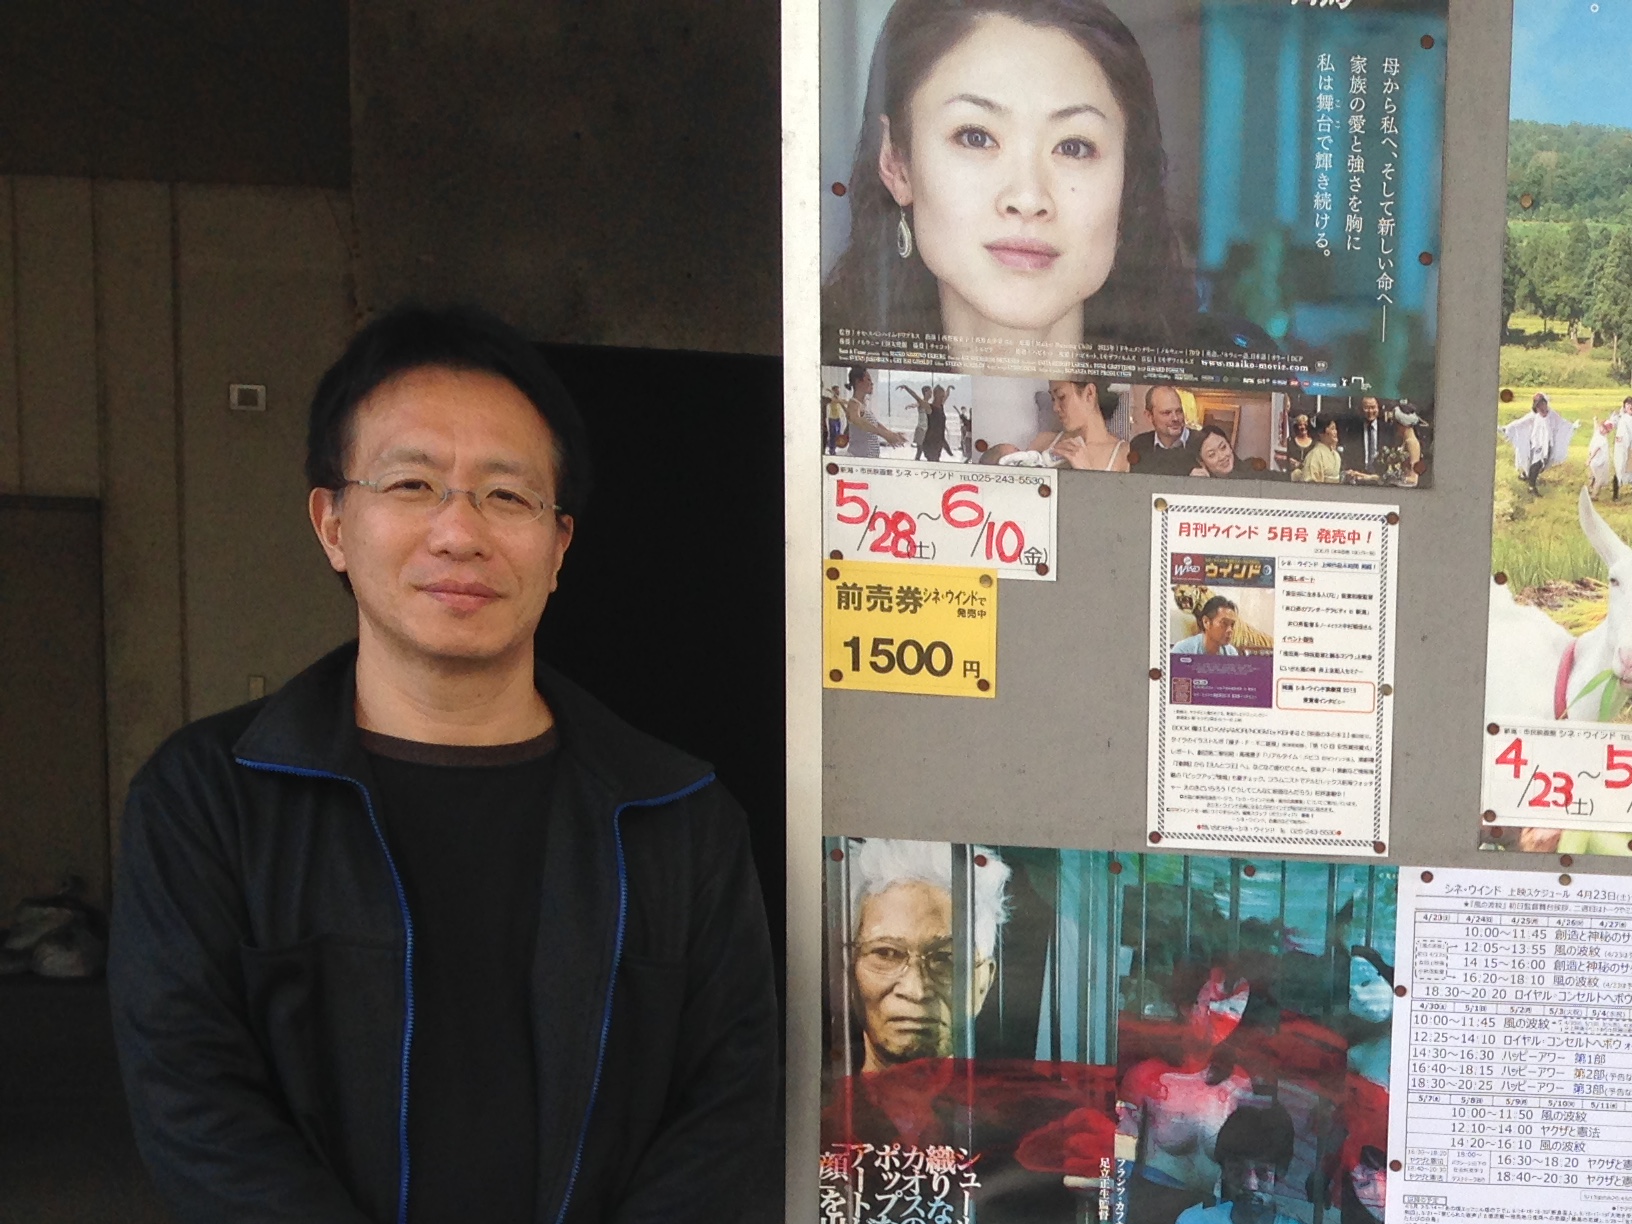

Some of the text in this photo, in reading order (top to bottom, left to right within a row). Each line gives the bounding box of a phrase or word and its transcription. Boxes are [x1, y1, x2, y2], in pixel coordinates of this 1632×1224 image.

[1313, 53, 1335, 256] 私は舞台で輝き続ける。
[1345, 55, 1367, 250] 家族の愛と強さを胸に
[1178, 521, 1259, 541] 月刊ウインド
[1267, 526, 1308, 543] 5月号
[1205, 561, 1261, 580] ウインド
[836, 582, 923, 614] 前売券
[957, 608, 987, 619] 発売中
[843, 636, 981, 678] 1500 円
